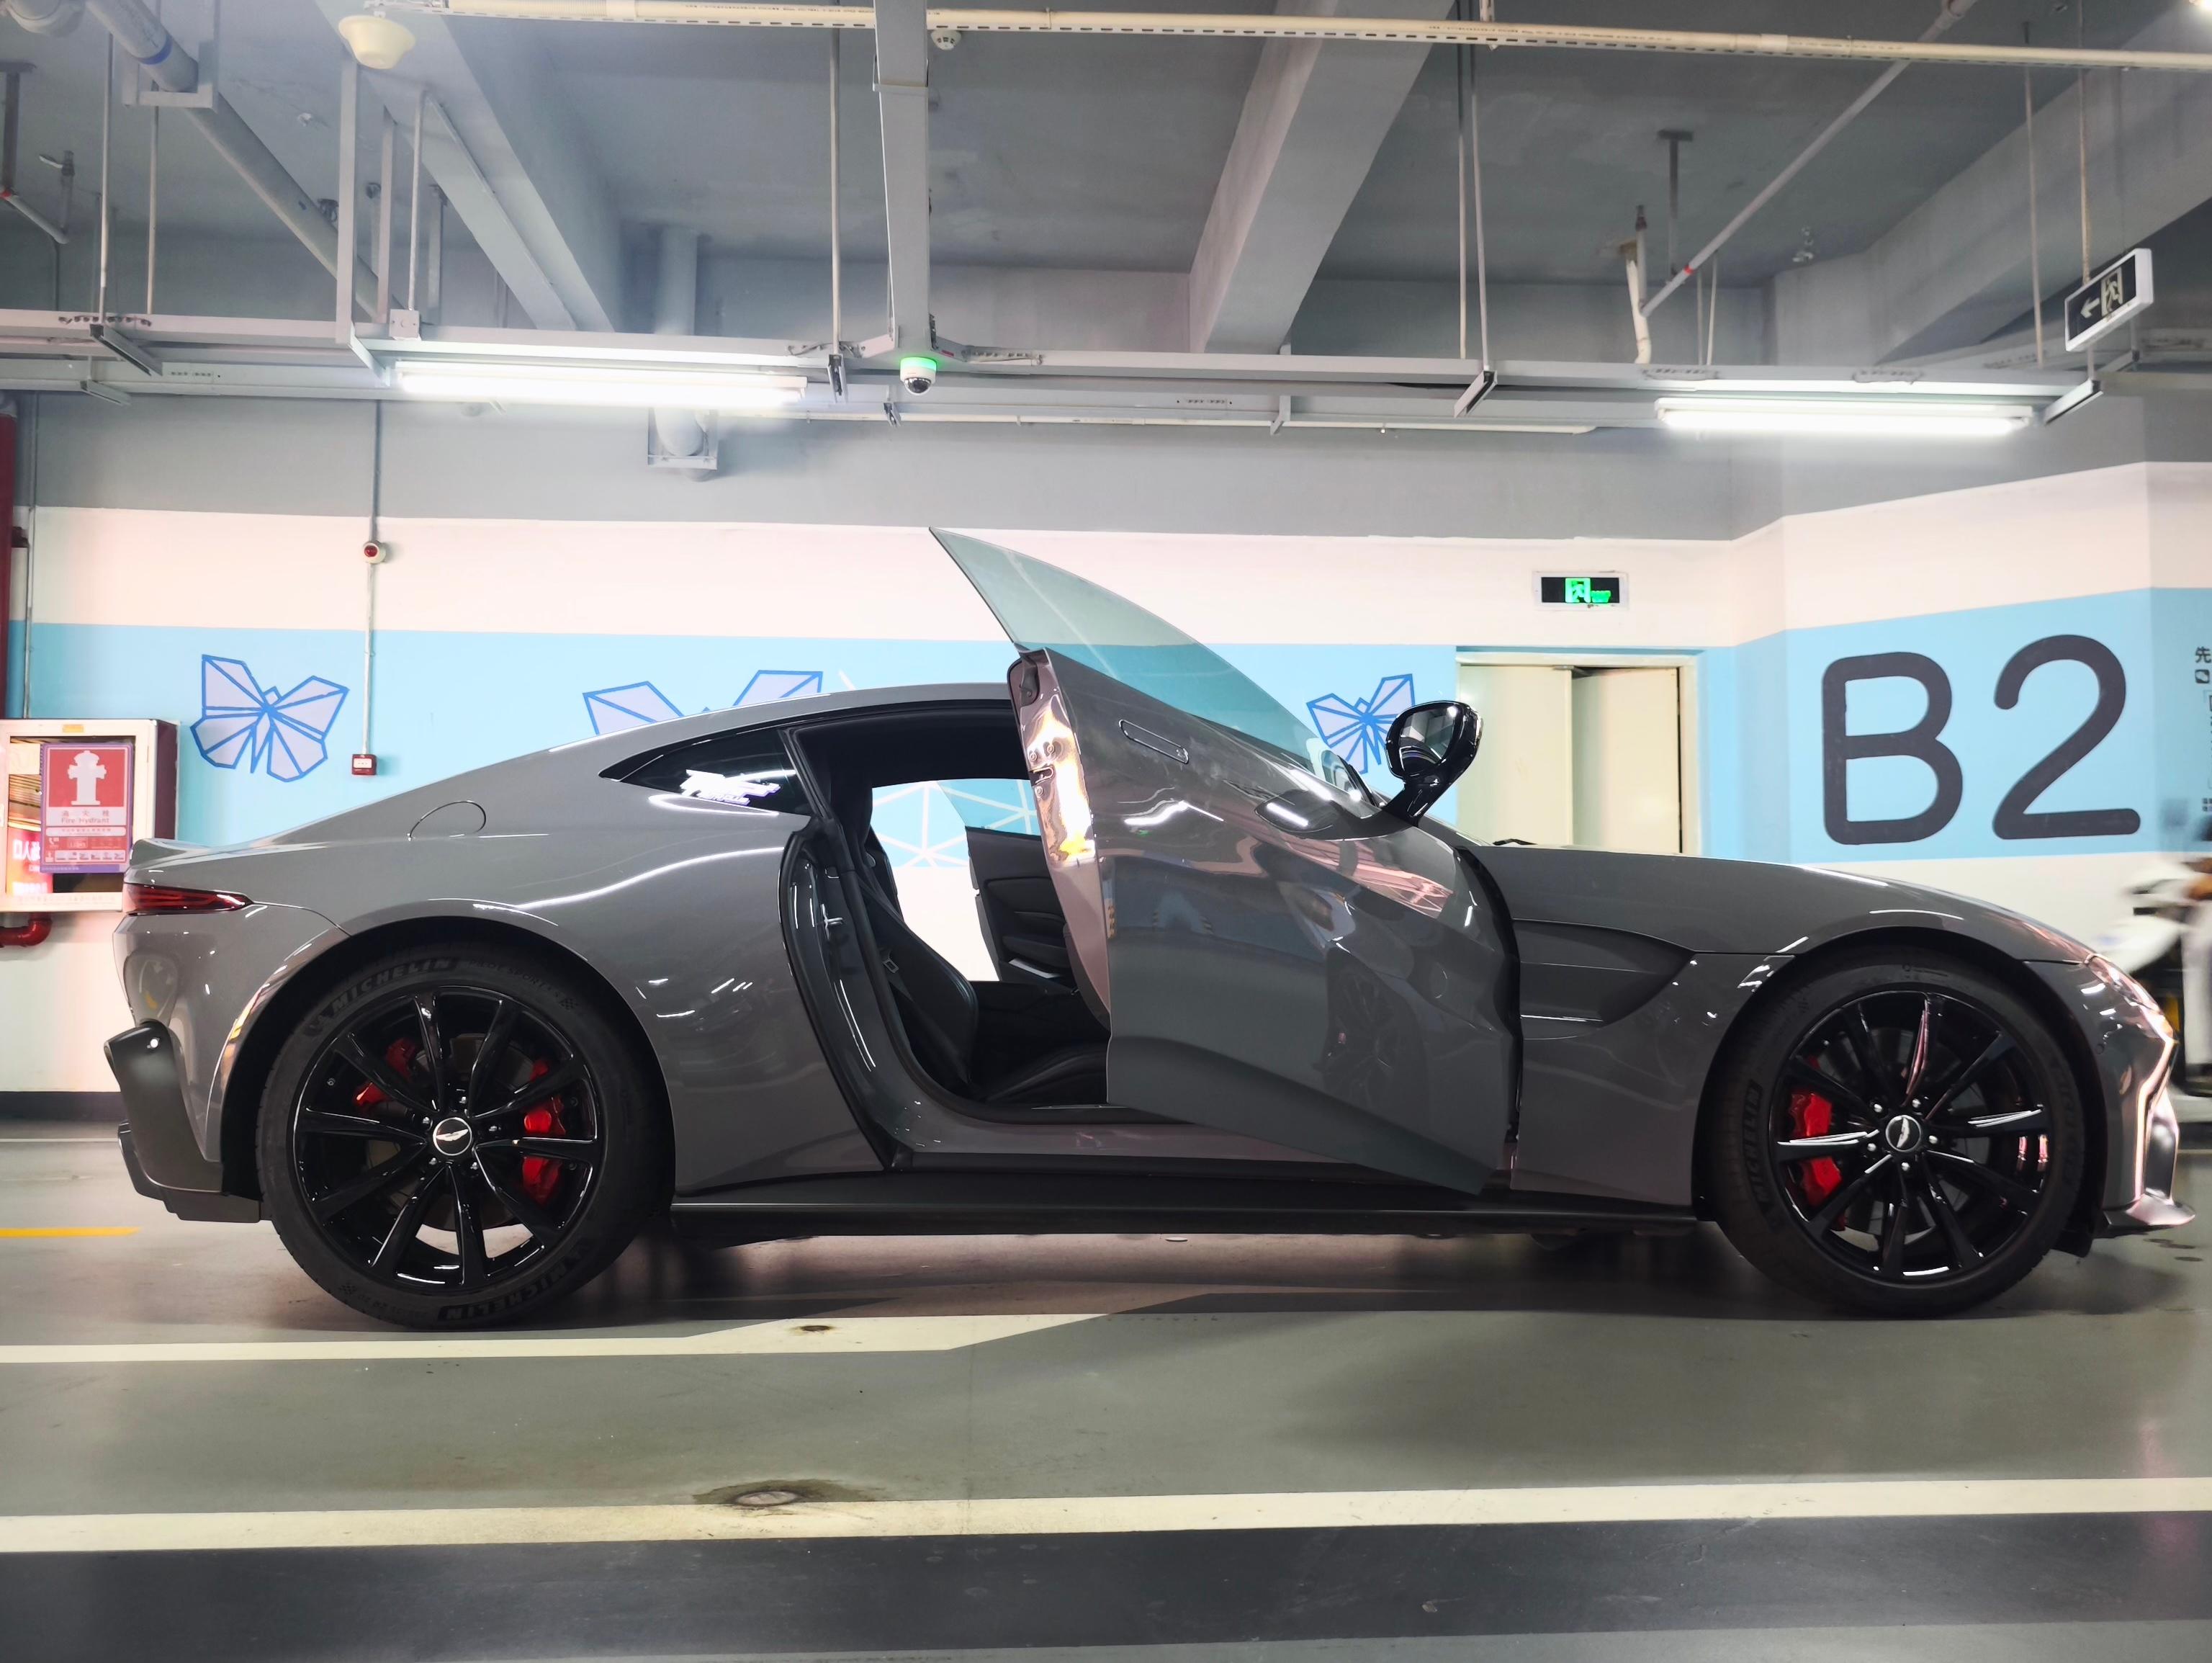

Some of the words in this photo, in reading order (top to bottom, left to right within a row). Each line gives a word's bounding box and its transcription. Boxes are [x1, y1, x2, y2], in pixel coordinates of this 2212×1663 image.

[2195, 646, 2212, 663] 先
[1822, 635, 2141, 845] B2
[332, 959, 451, 1011] MICHELIN
[1744, 1086, 1768, 1202] MICHELIN
[446, 1260, 570, 1321] MICHELIN
